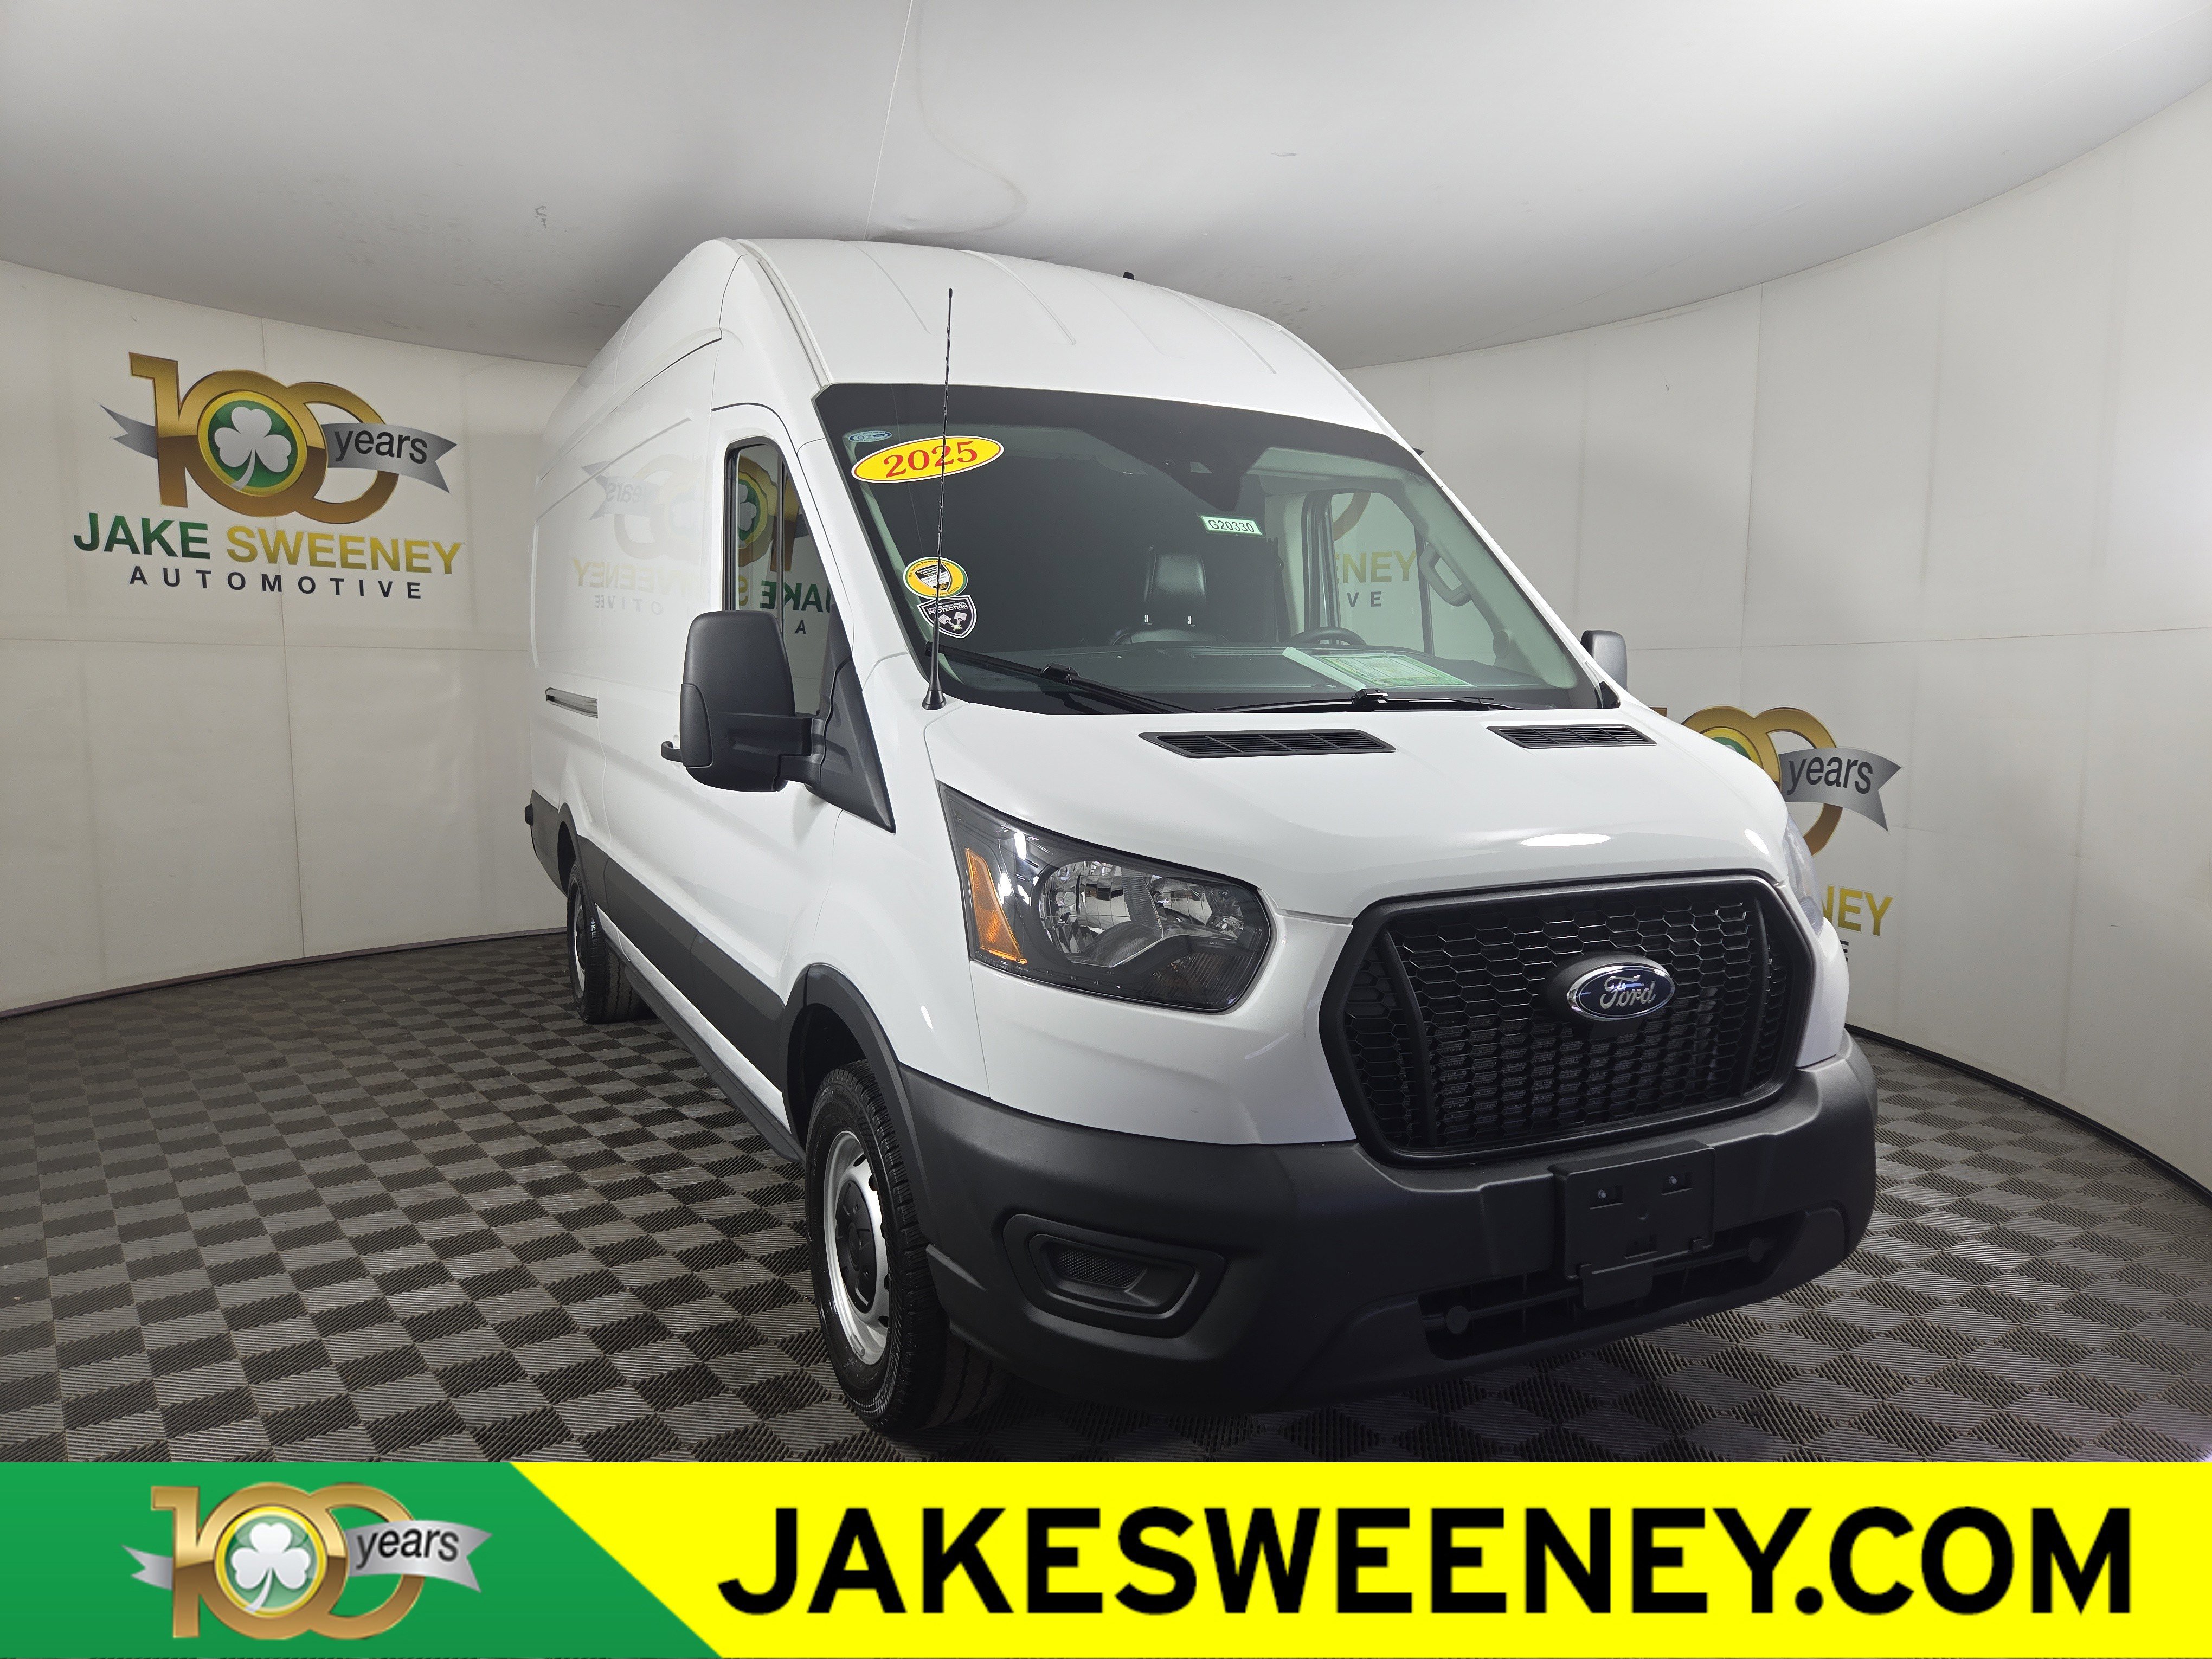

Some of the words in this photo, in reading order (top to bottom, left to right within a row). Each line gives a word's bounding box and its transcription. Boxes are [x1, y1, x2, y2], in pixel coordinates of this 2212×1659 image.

[333, 429, 428, 465] years
[883, 440, 978, 478] 2025
[74, 512, 211, 560] JAKE
[227, 525, 463, 575] SWEENEY
[1208, 519, 1255, 532] G20330
[129, 565, 422, 600] AUTOMOTIVE
[1786, 756, 1873, 796] years
[1599, 974, 1656, 1009] Ford
